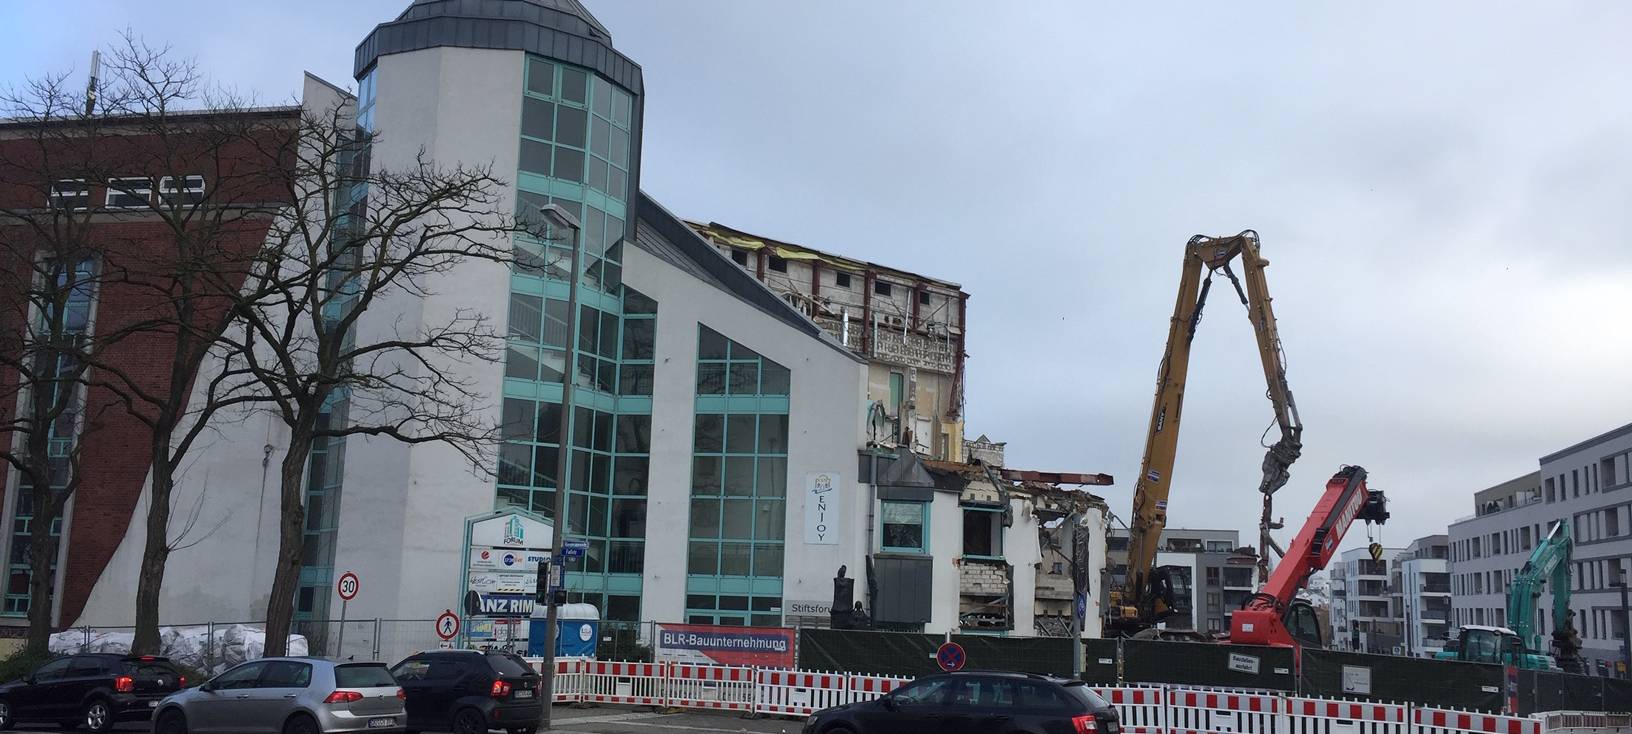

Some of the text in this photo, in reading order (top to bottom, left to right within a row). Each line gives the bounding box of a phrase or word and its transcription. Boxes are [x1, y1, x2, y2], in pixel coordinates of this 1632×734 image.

[816, 495, 826, 541] ENJOY
[1336, 488, 1363, 540] MANITOU
[503, 535, 524, 545] FORUM
[342, 580, 355, 593] 30
[510, 599, 536, 613] RIM
[664, 632, 786, 651] BLR-Bauunternehmung
